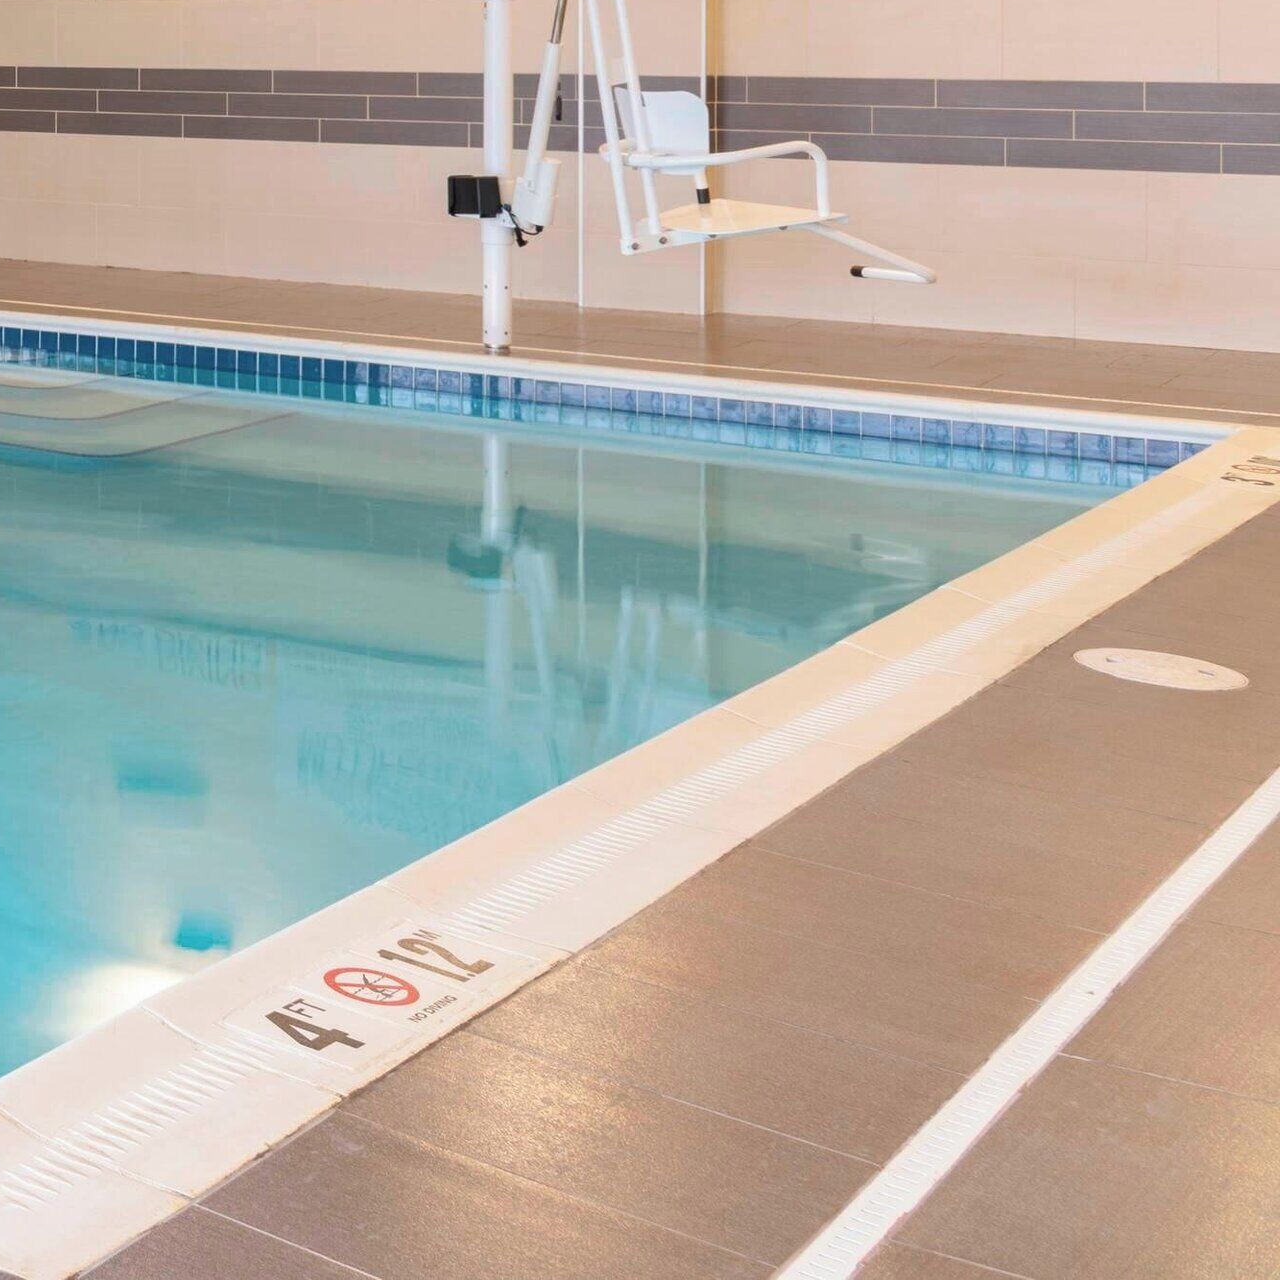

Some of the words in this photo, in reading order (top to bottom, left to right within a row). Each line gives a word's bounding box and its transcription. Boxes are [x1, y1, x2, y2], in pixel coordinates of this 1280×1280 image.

[281, 998, 327, 1019] FT
[408, 1009, 428, 1024] NO
[423, 994, 457, 1016] DIVING
[265, 1010, 366, 1052] 4
